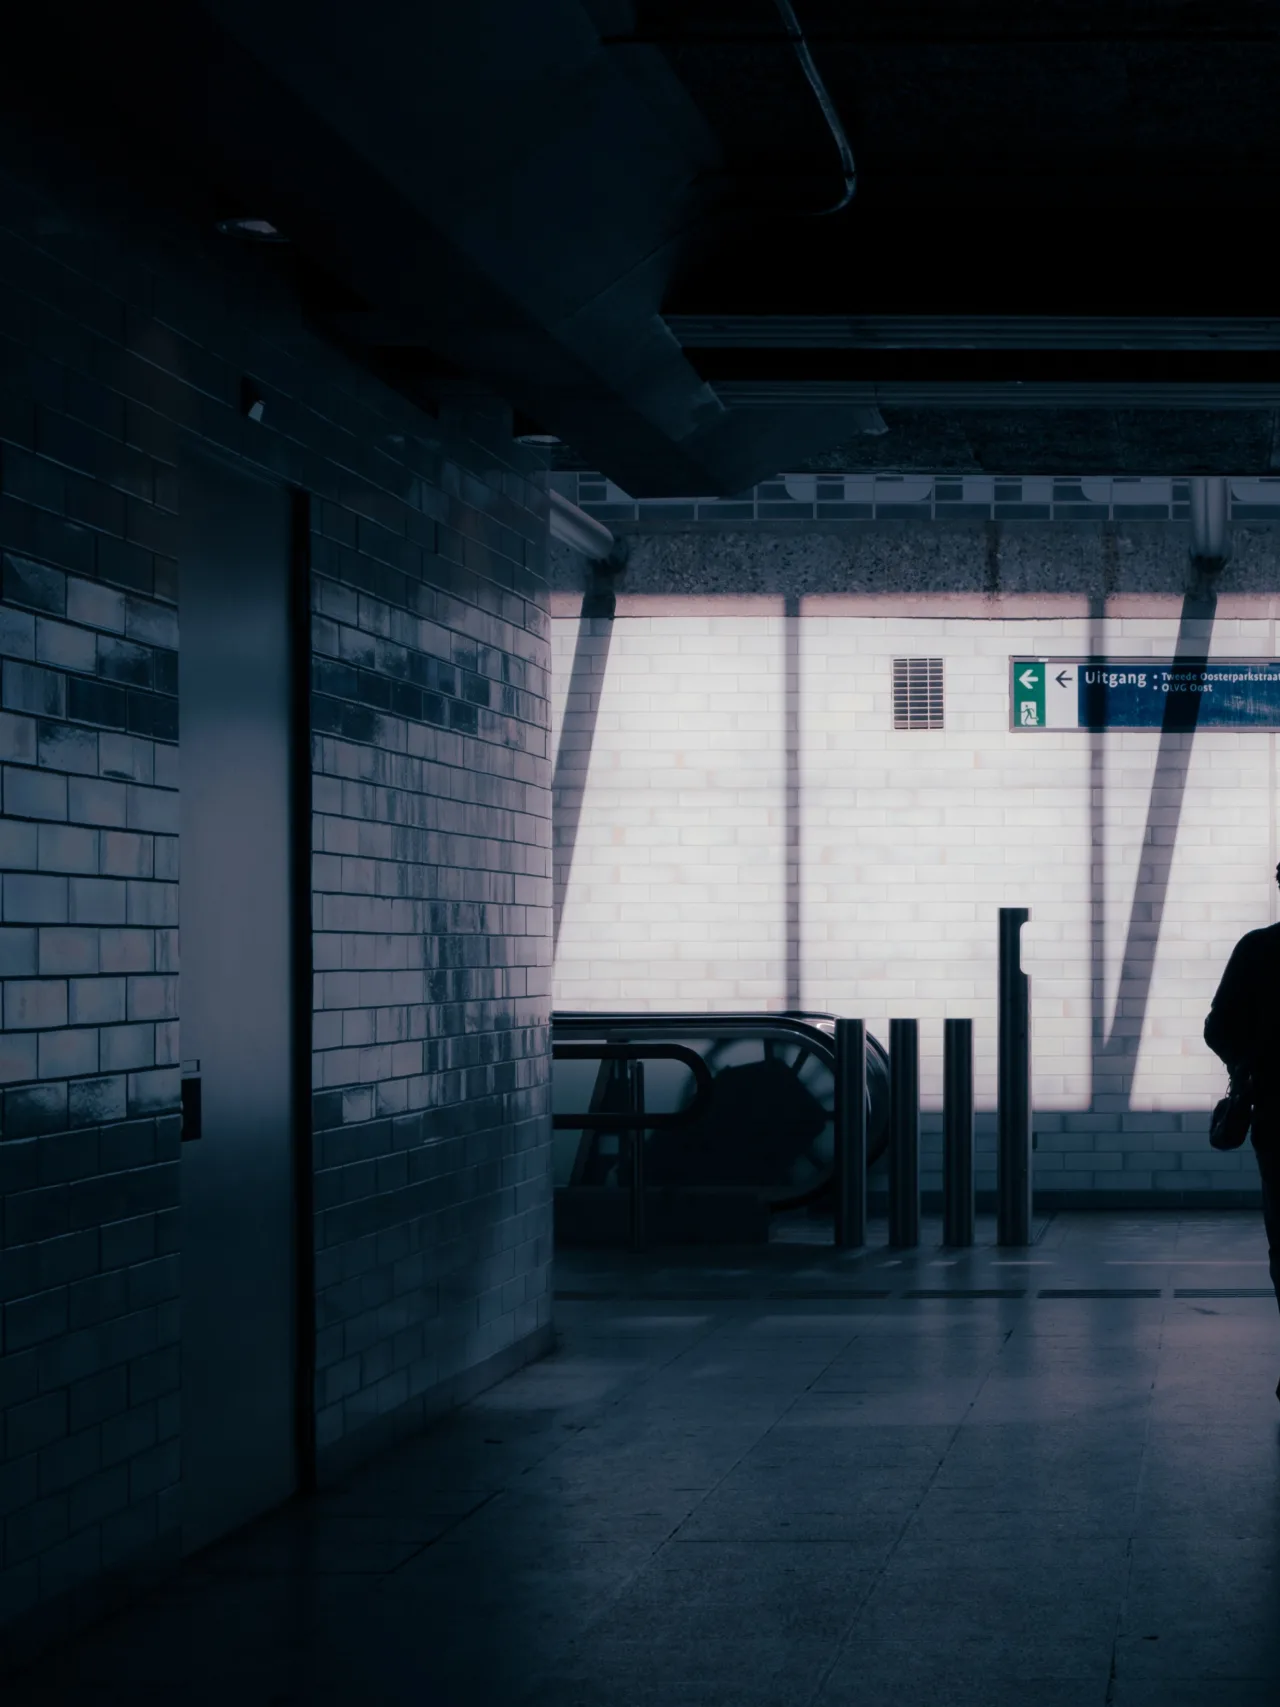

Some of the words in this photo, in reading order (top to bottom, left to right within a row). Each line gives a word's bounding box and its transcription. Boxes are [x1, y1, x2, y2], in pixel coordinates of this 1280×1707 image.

[1085, 671, 1147, 688] Uitgang
[1161, 672, 1197, 681] Tweede
[1161, 684, 1187, 692] OLVG
[1189, 684, 1213, 692] Oost
